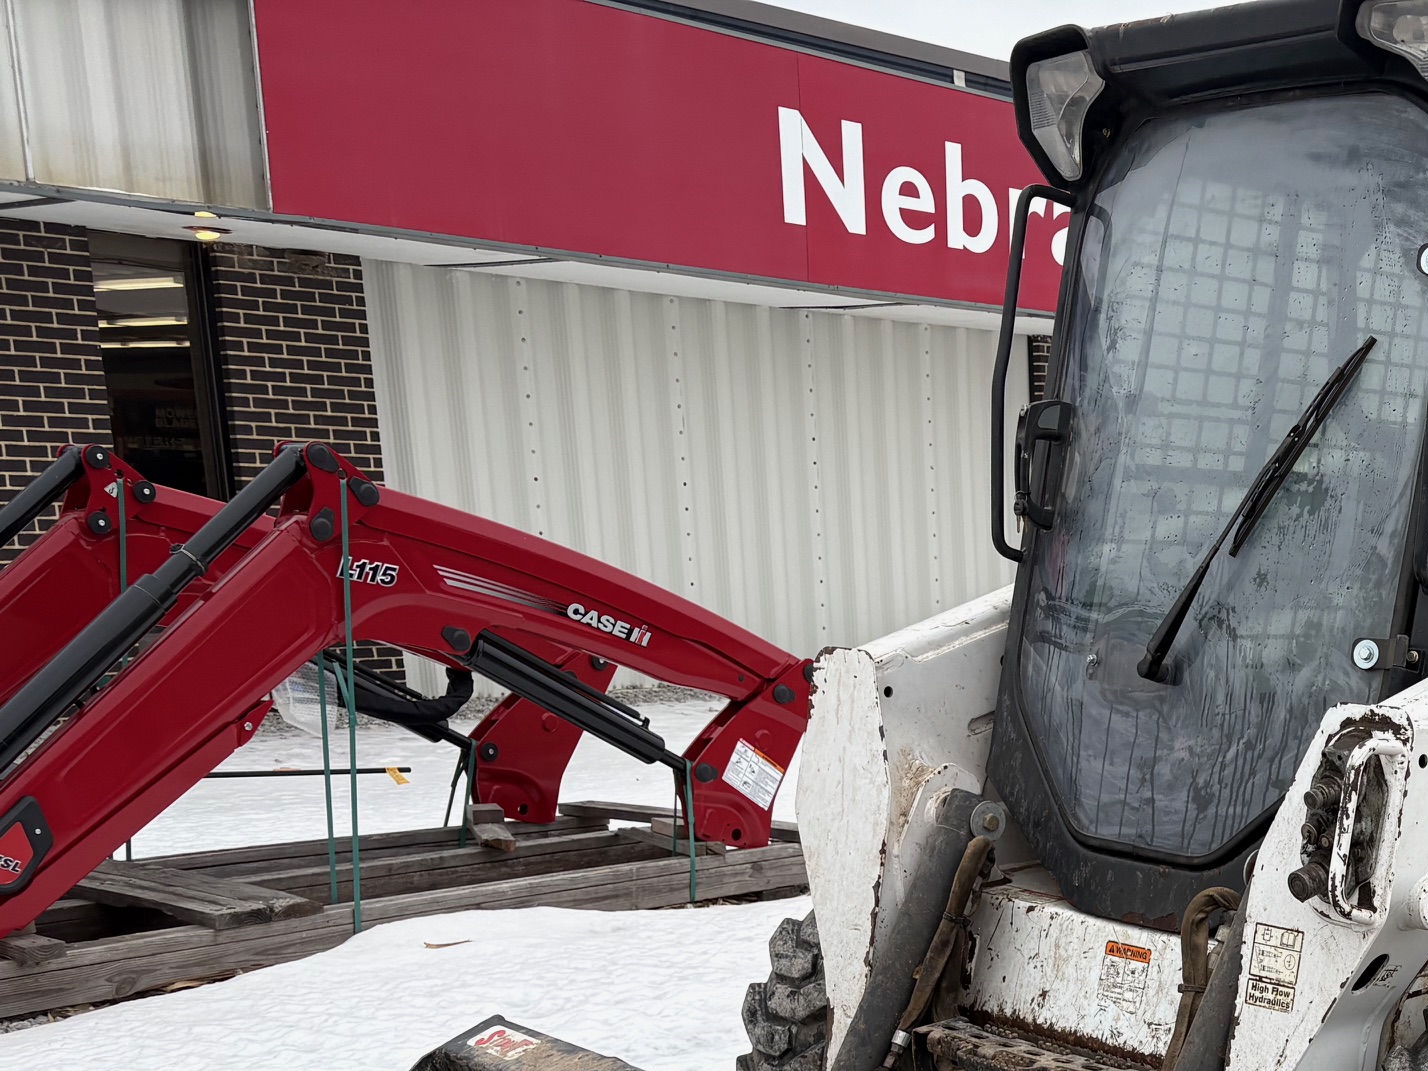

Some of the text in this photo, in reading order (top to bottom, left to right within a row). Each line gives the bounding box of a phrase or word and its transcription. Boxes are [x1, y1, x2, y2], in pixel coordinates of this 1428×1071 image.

[336, 555, 399, 588] L115
[566, 603, 631, 639] CASE
[0, 854, 21, 874] SL
[1116, 945, 1147, 960] WARNING
[1251, 981, 1270, 995] High
[1271, 985, 1291, 998] Flow
[1248, 992, 1290, 1010] Hydraulics
